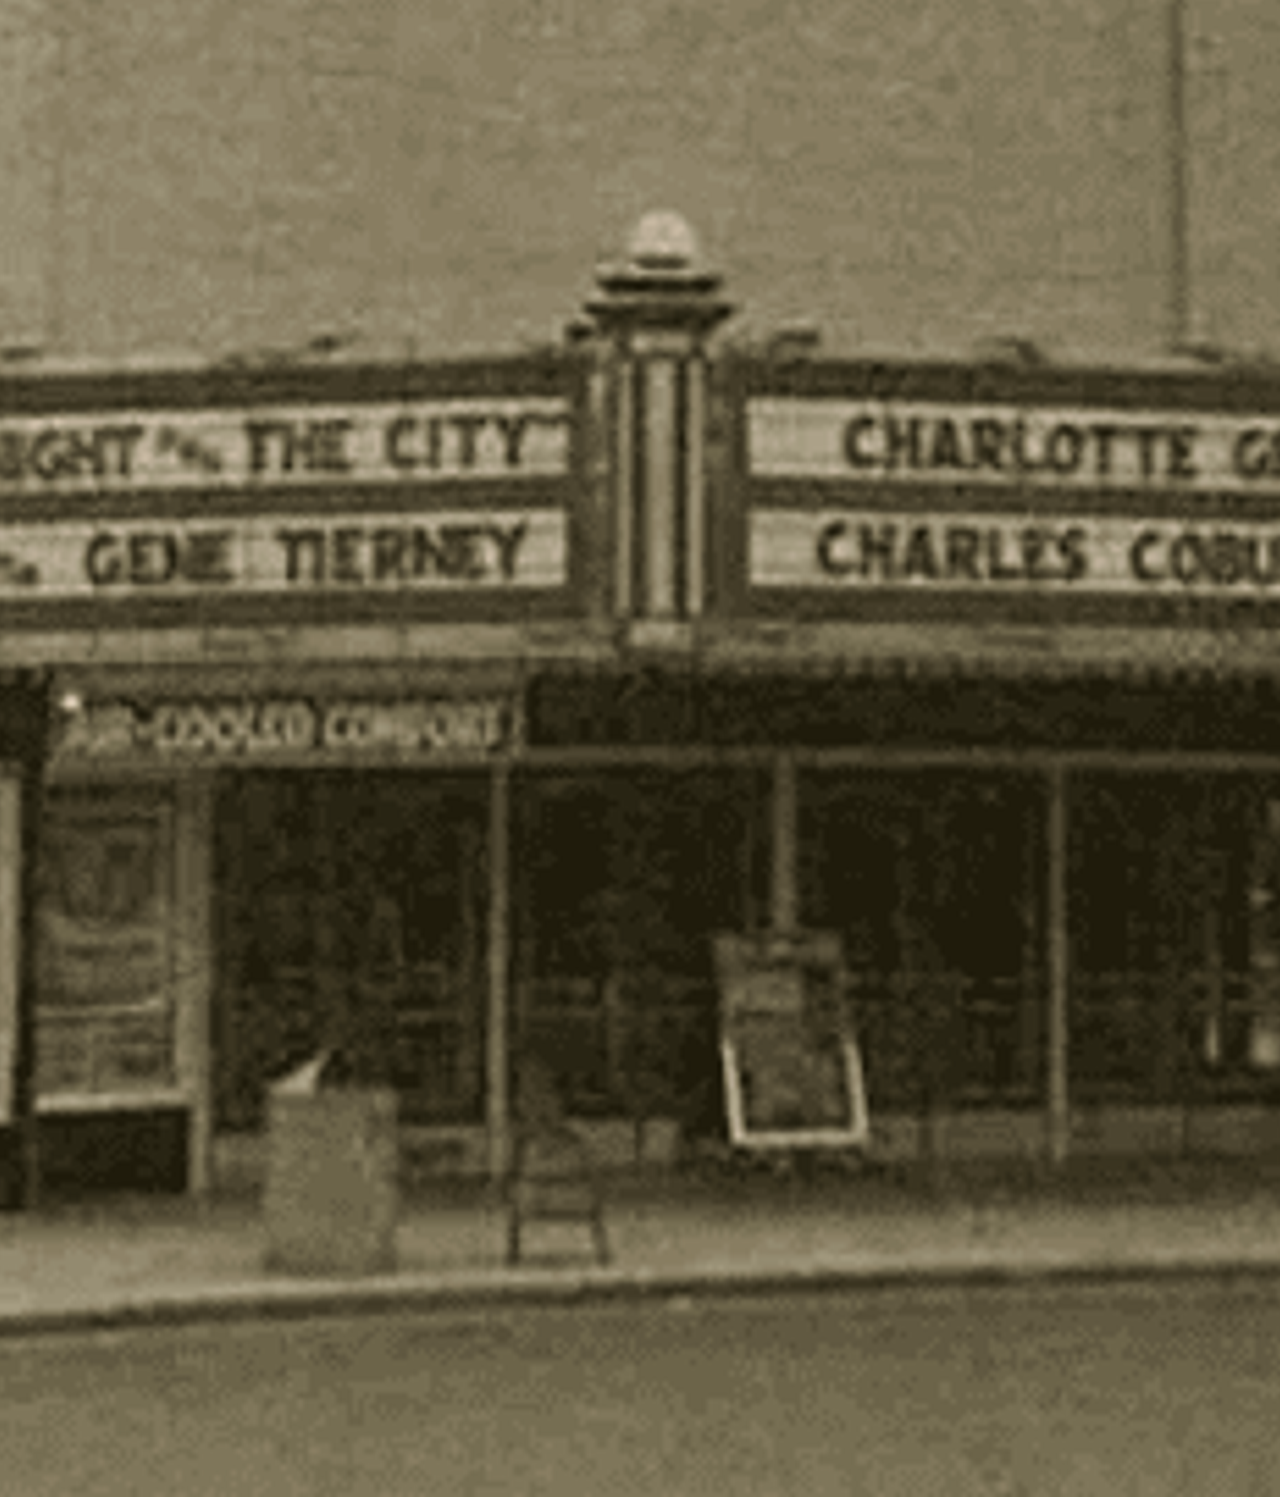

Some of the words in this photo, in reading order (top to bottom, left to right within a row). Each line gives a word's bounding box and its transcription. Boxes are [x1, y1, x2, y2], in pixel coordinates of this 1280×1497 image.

[244, 416, 354, 472] THE
[841, 414, 1199, 478] CHARLOTTE
[84, 526, 238, 587] GENE
[274, 519, 528, 583] TIERNEY
[817, 520, 1087, 584] CHARLES
